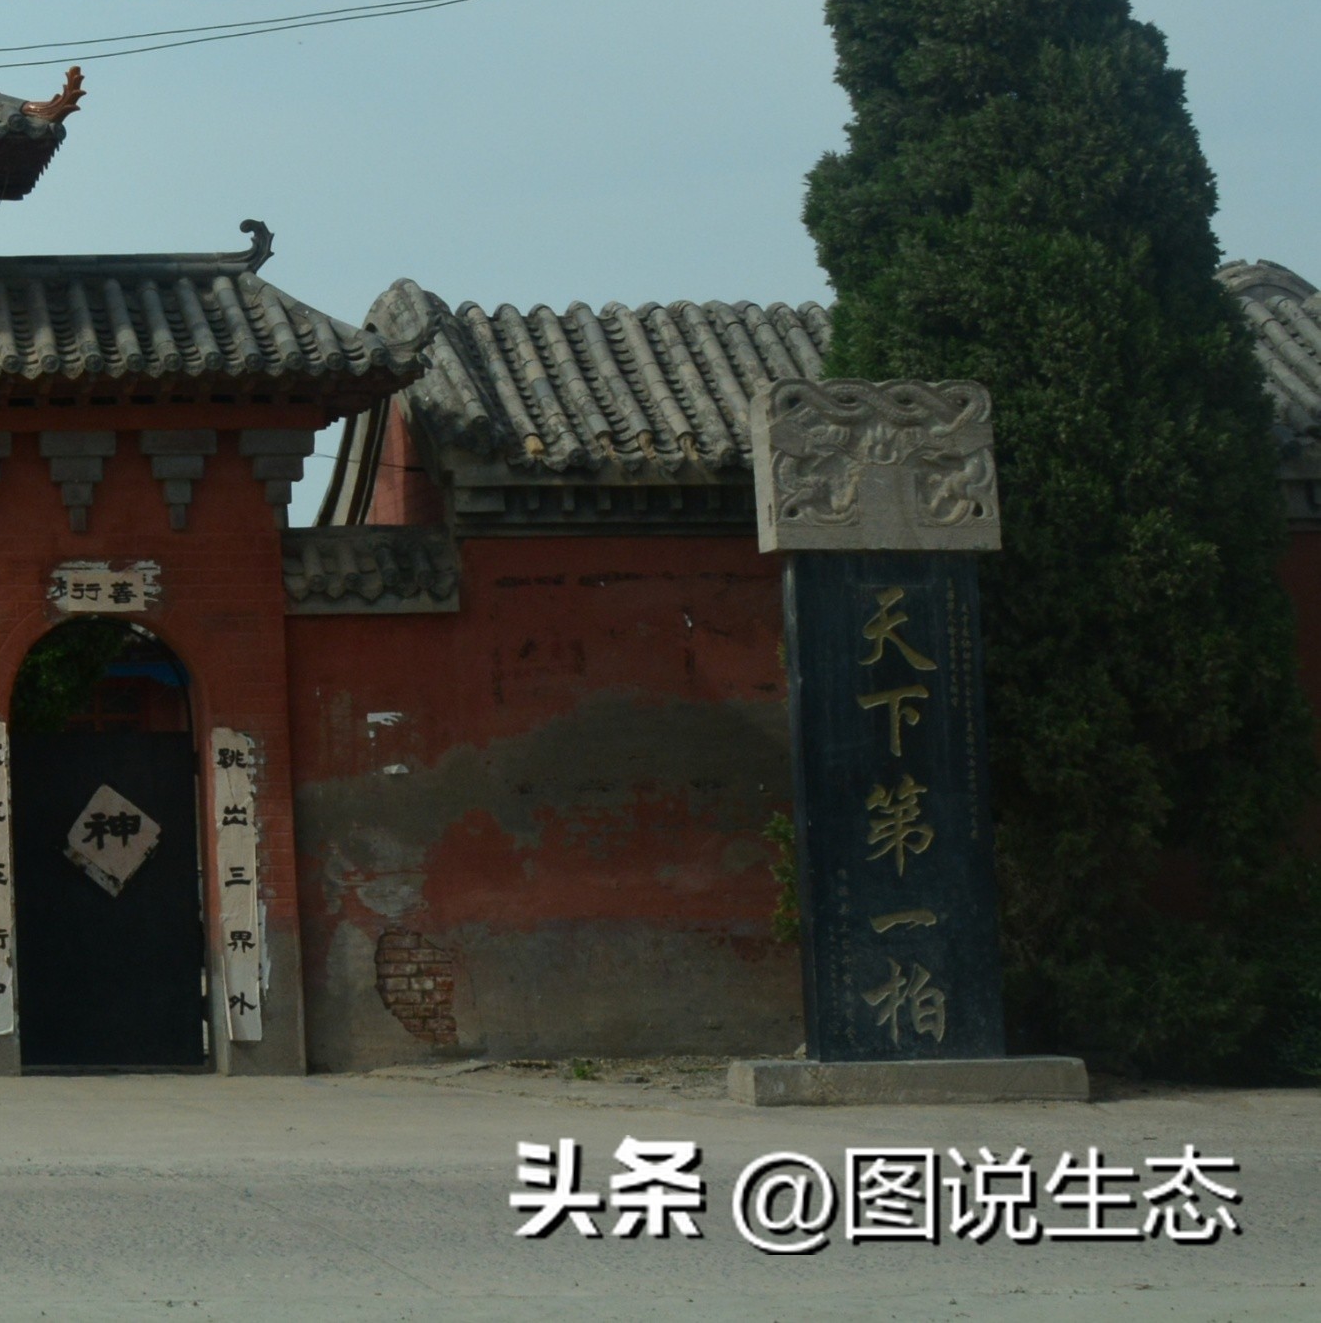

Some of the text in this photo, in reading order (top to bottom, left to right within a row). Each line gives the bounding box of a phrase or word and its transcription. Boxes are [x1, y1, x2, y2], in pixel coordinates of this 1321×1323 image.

[71, 581, 137, 604] 行善
[83, 811, 142, 849] 神
[216, 747, 257, 1017] 跳出三界外
[856, 585, 948, 1046] 天下第一柏
